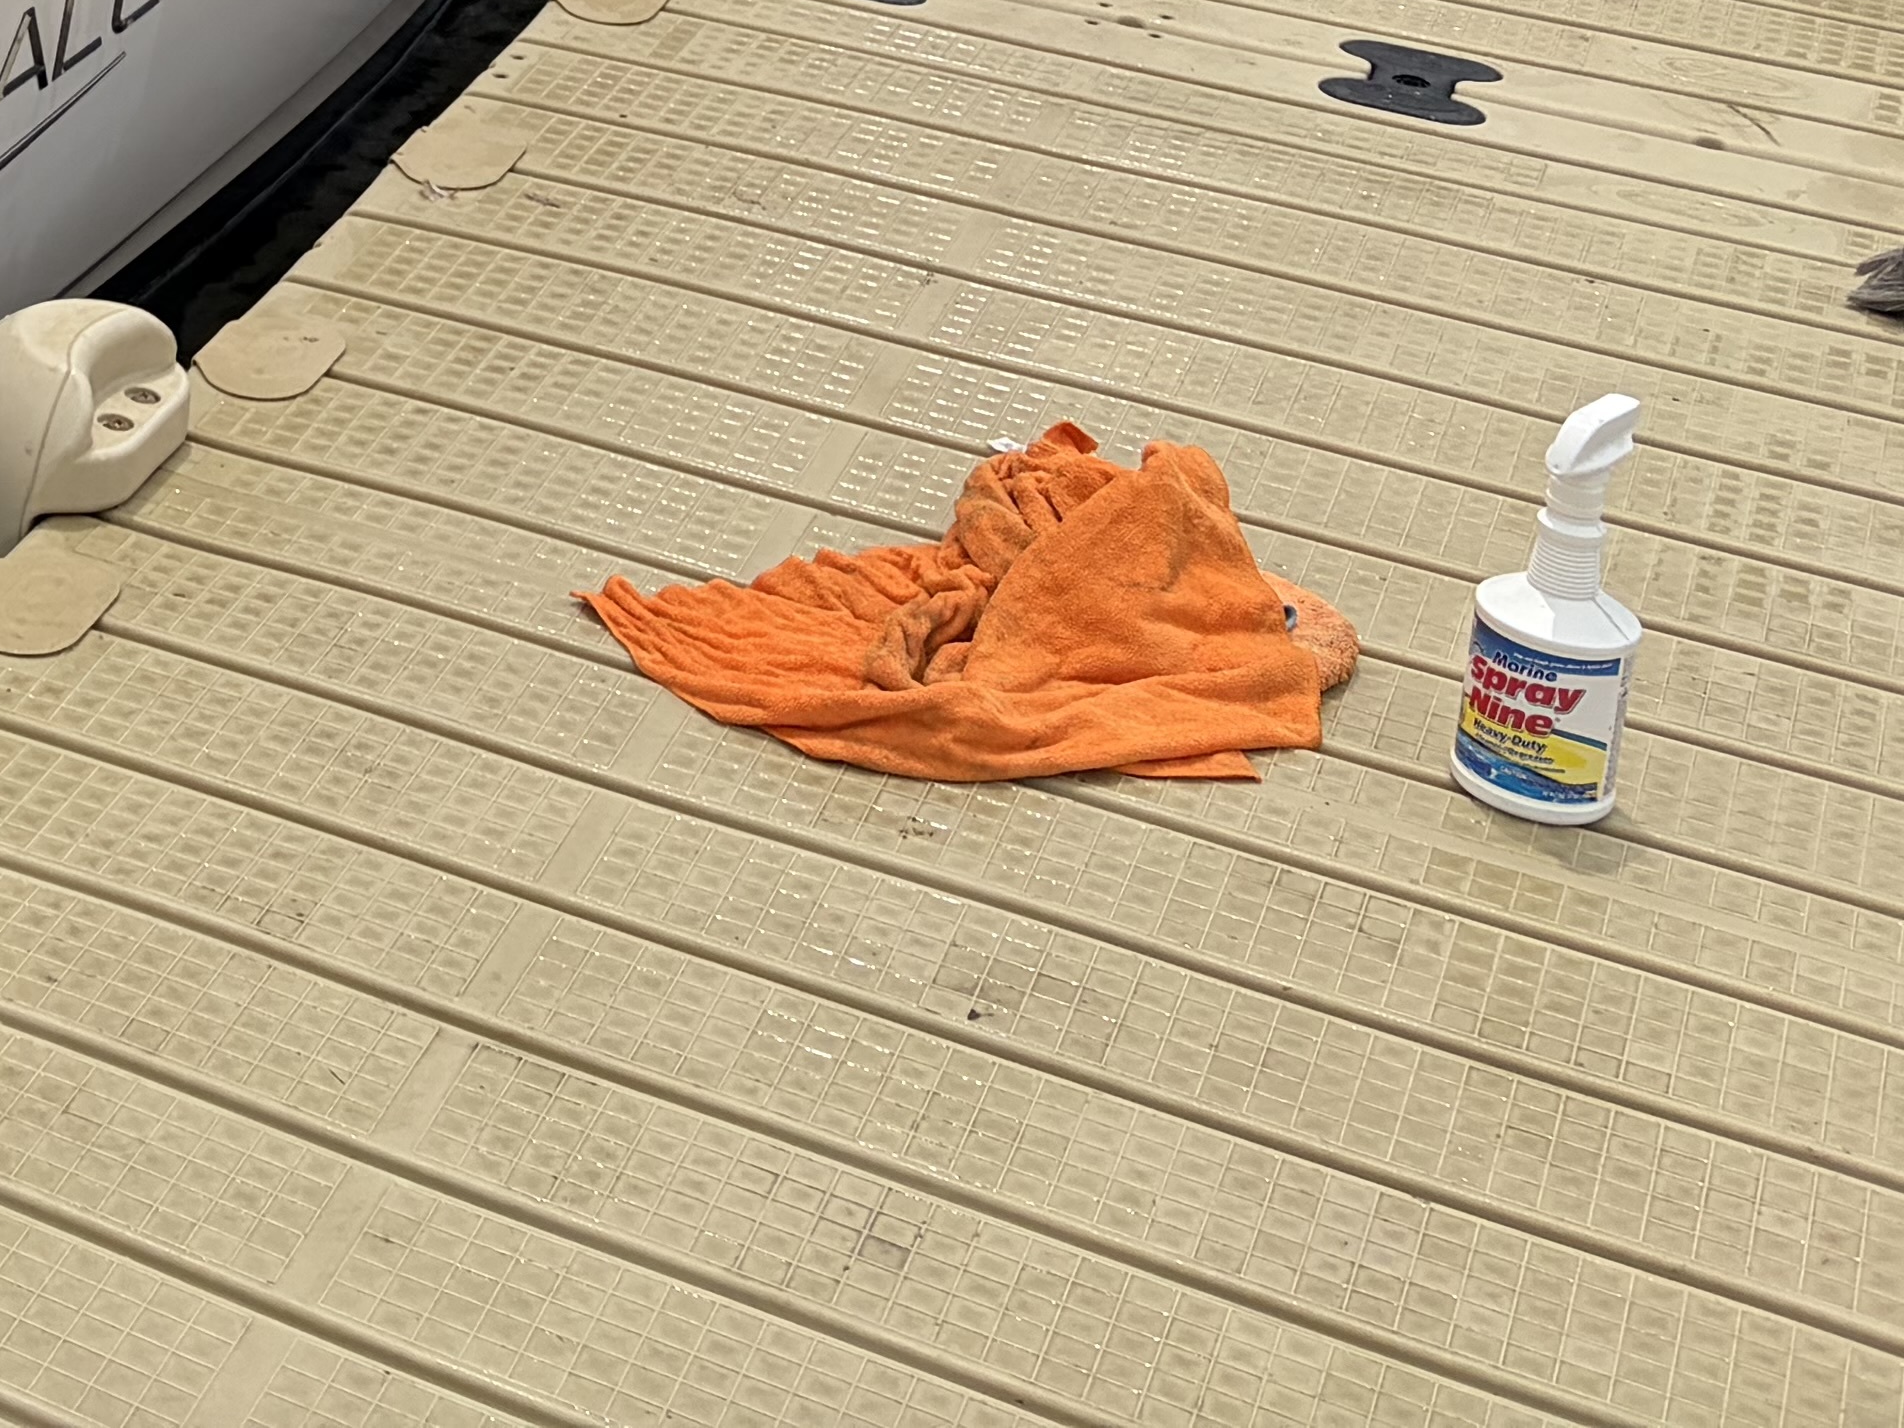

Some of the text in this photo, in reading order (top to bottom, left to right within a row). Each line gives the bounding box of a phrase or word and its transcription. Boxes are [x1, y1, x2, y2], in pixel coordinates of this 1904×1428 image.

[1470, 653, 1587, 715] Spray
[1492, 651, 1558, 682] Marine
[1469, 685, 1554, 738] Nine
